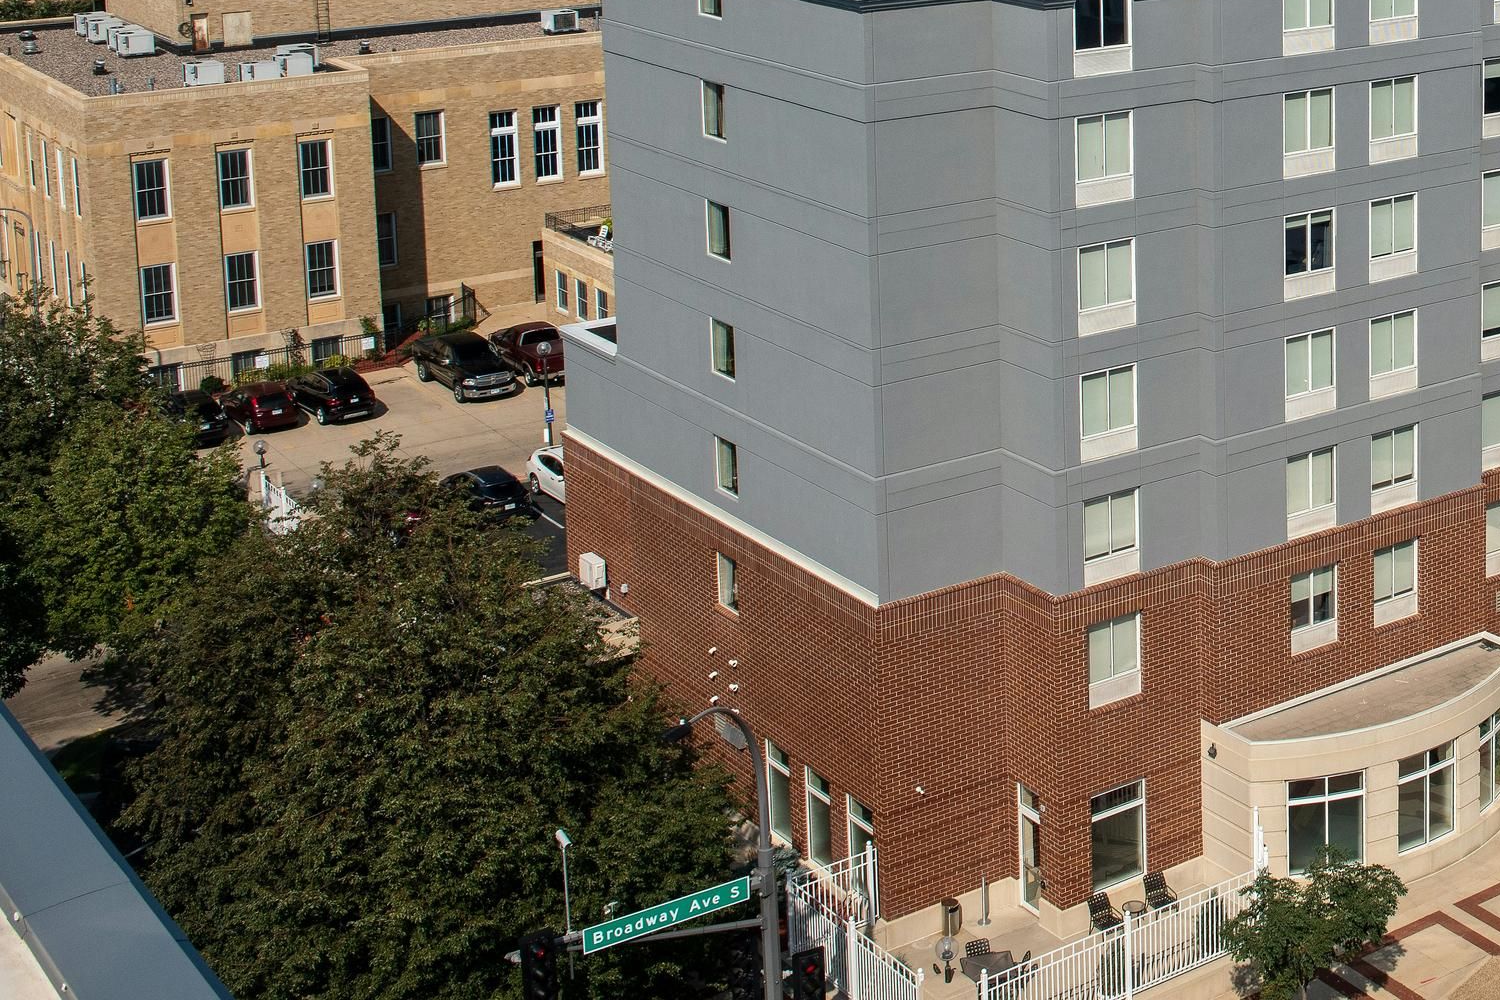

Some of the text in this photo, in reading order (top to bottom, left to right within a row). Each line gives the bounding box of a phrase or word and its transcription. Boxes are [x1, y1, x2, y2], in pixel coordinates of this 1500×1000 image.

[592, 886, 740, 945] Broadway Ave S
